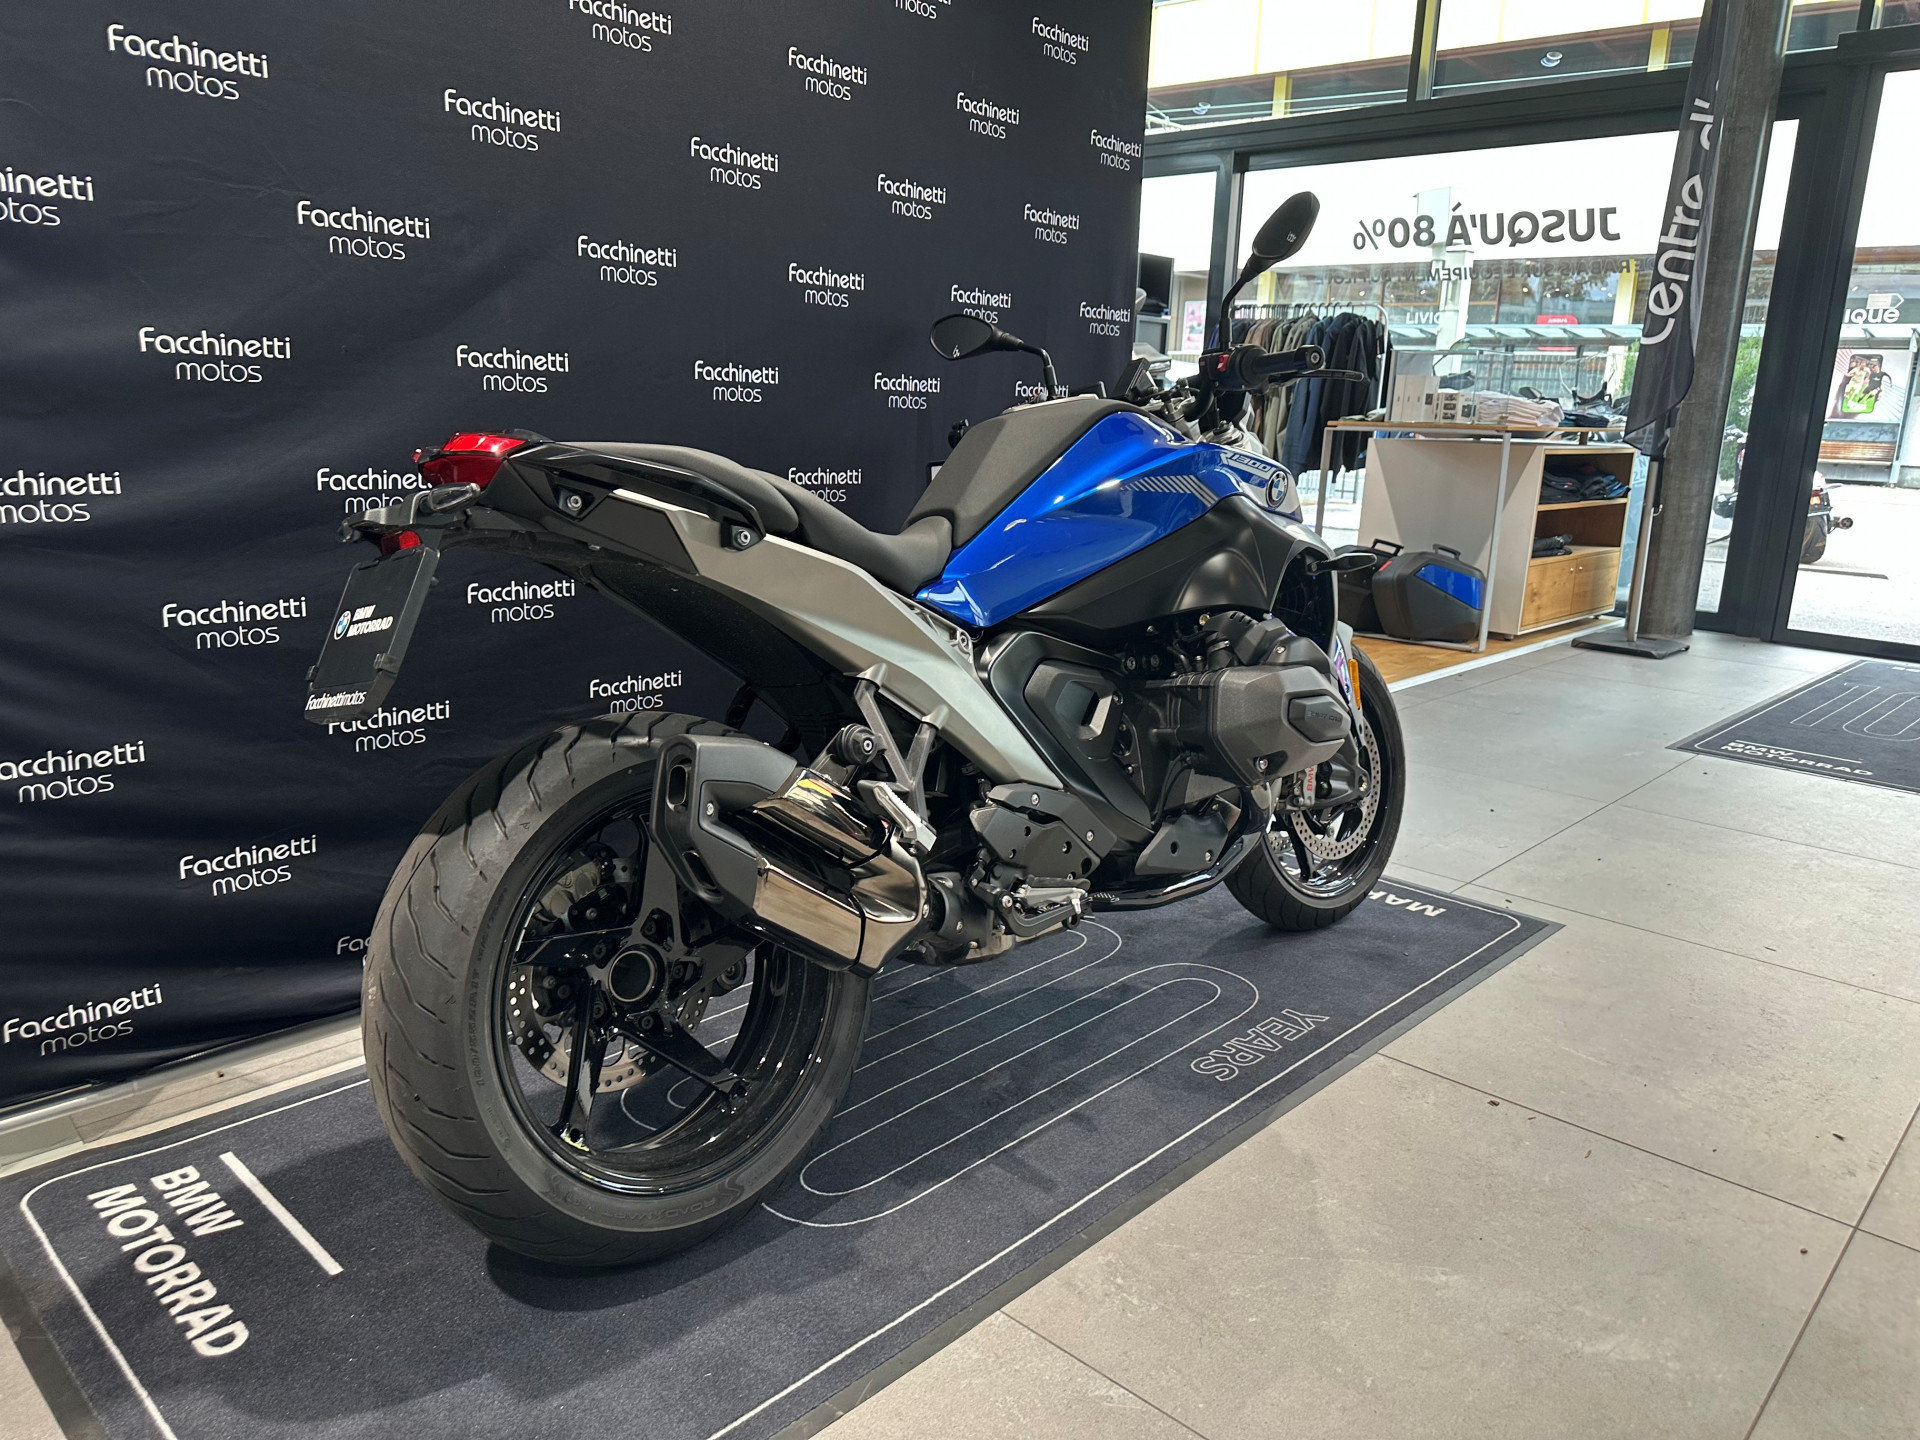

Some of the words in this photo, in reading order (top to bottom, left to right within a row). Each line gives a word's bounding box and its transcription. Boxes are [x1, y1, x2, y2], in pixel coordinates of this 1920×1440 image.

[593, 23, 651, 52] motos
[1033, 17, 1088, 51] Facchinetti
[107, 24, 268, 78] Facchinetti
[1044, 43, 1076, 64] motos
[789, 47, 867, 85] Facchinetti
[147, 67, 239, 100] motos
[806, 77, 851, 100] motos
[445, 89, 560, 132] Facchinetti
[957, 92, 1019, 125] Facchinetti
[472, 125, 538, 151] motos
[970, 116, 1005, 139] motos
[691, 137, 778, 172] Facchinetti
[1091, 130, 1141, 157] Facchinetti
[1101, 151, 1130, 170] motos
[711, 167, 761, 189] motos
[878, 174, 946, 204] Facchinetti
[298, 201, 430, 238] Facchinetti
[892, 200, 931, 219] motos
[1024, 204, 1079, 229] Facchinetti
[1035, 226, 1067, 244] motos
[330, 236, 405, 260] motos
[578, 236, 676, 267] Facchinetti
[601, 265, 657, 286] motos
[789, 263, 864, 290] Facchinetti
[805, 288, 848, 307] motos
[951, 285, 1011, 308] Facchinetti
[1080, 302, 1130, 322] Facchinetti
[1090, 321, 1119, 336] motos
[139, 327, 290, 358] Facchinetti
[457, 345, 568, 372] Facchinetti
[177, 360, 262, 382] motos
[484, 373, 547, 392] motos
[695, 360, 778, 384] Facchinetti
[875, 373, 940, 392] Facchinetti
[714, 384, 761, 402] motos
[889, 392, 926, 409] motos
[788, 467, 861, 485] Facchinetti
[809, 487, 847, 502] otos
[468, 580, 574, 604] Facchinetti
[163, 597, 306, 627] Facchinetti
[352, 605, 376, 621] BMW
[492, 603, 554, 622] motos
[197, 626, 279, 649] motos
[346, 616, 394, 638] MOTORRAD
[590, 670, 681, 698] Facchinetti
[611, 694, 663, 714] motos
[356, 729, 426, 752] motos
[1728, 741, 1794, 757] BMW
[1720, 744, 1874, 777] MOTORRAD
[19, 774, 114, 802] motos
[180, 835, 316, 879] Facchinetti
[213, 865, 291, 896] motos
[3, 984, 162, 1044] Facchinetti
[40, 1017, 133, 1055] motos
[1190, 1008, 1330, 1082] YEARS
[150, 1165, 244, 1237] BMW
[87, 1182, 250, 1356] MOTORRAD
